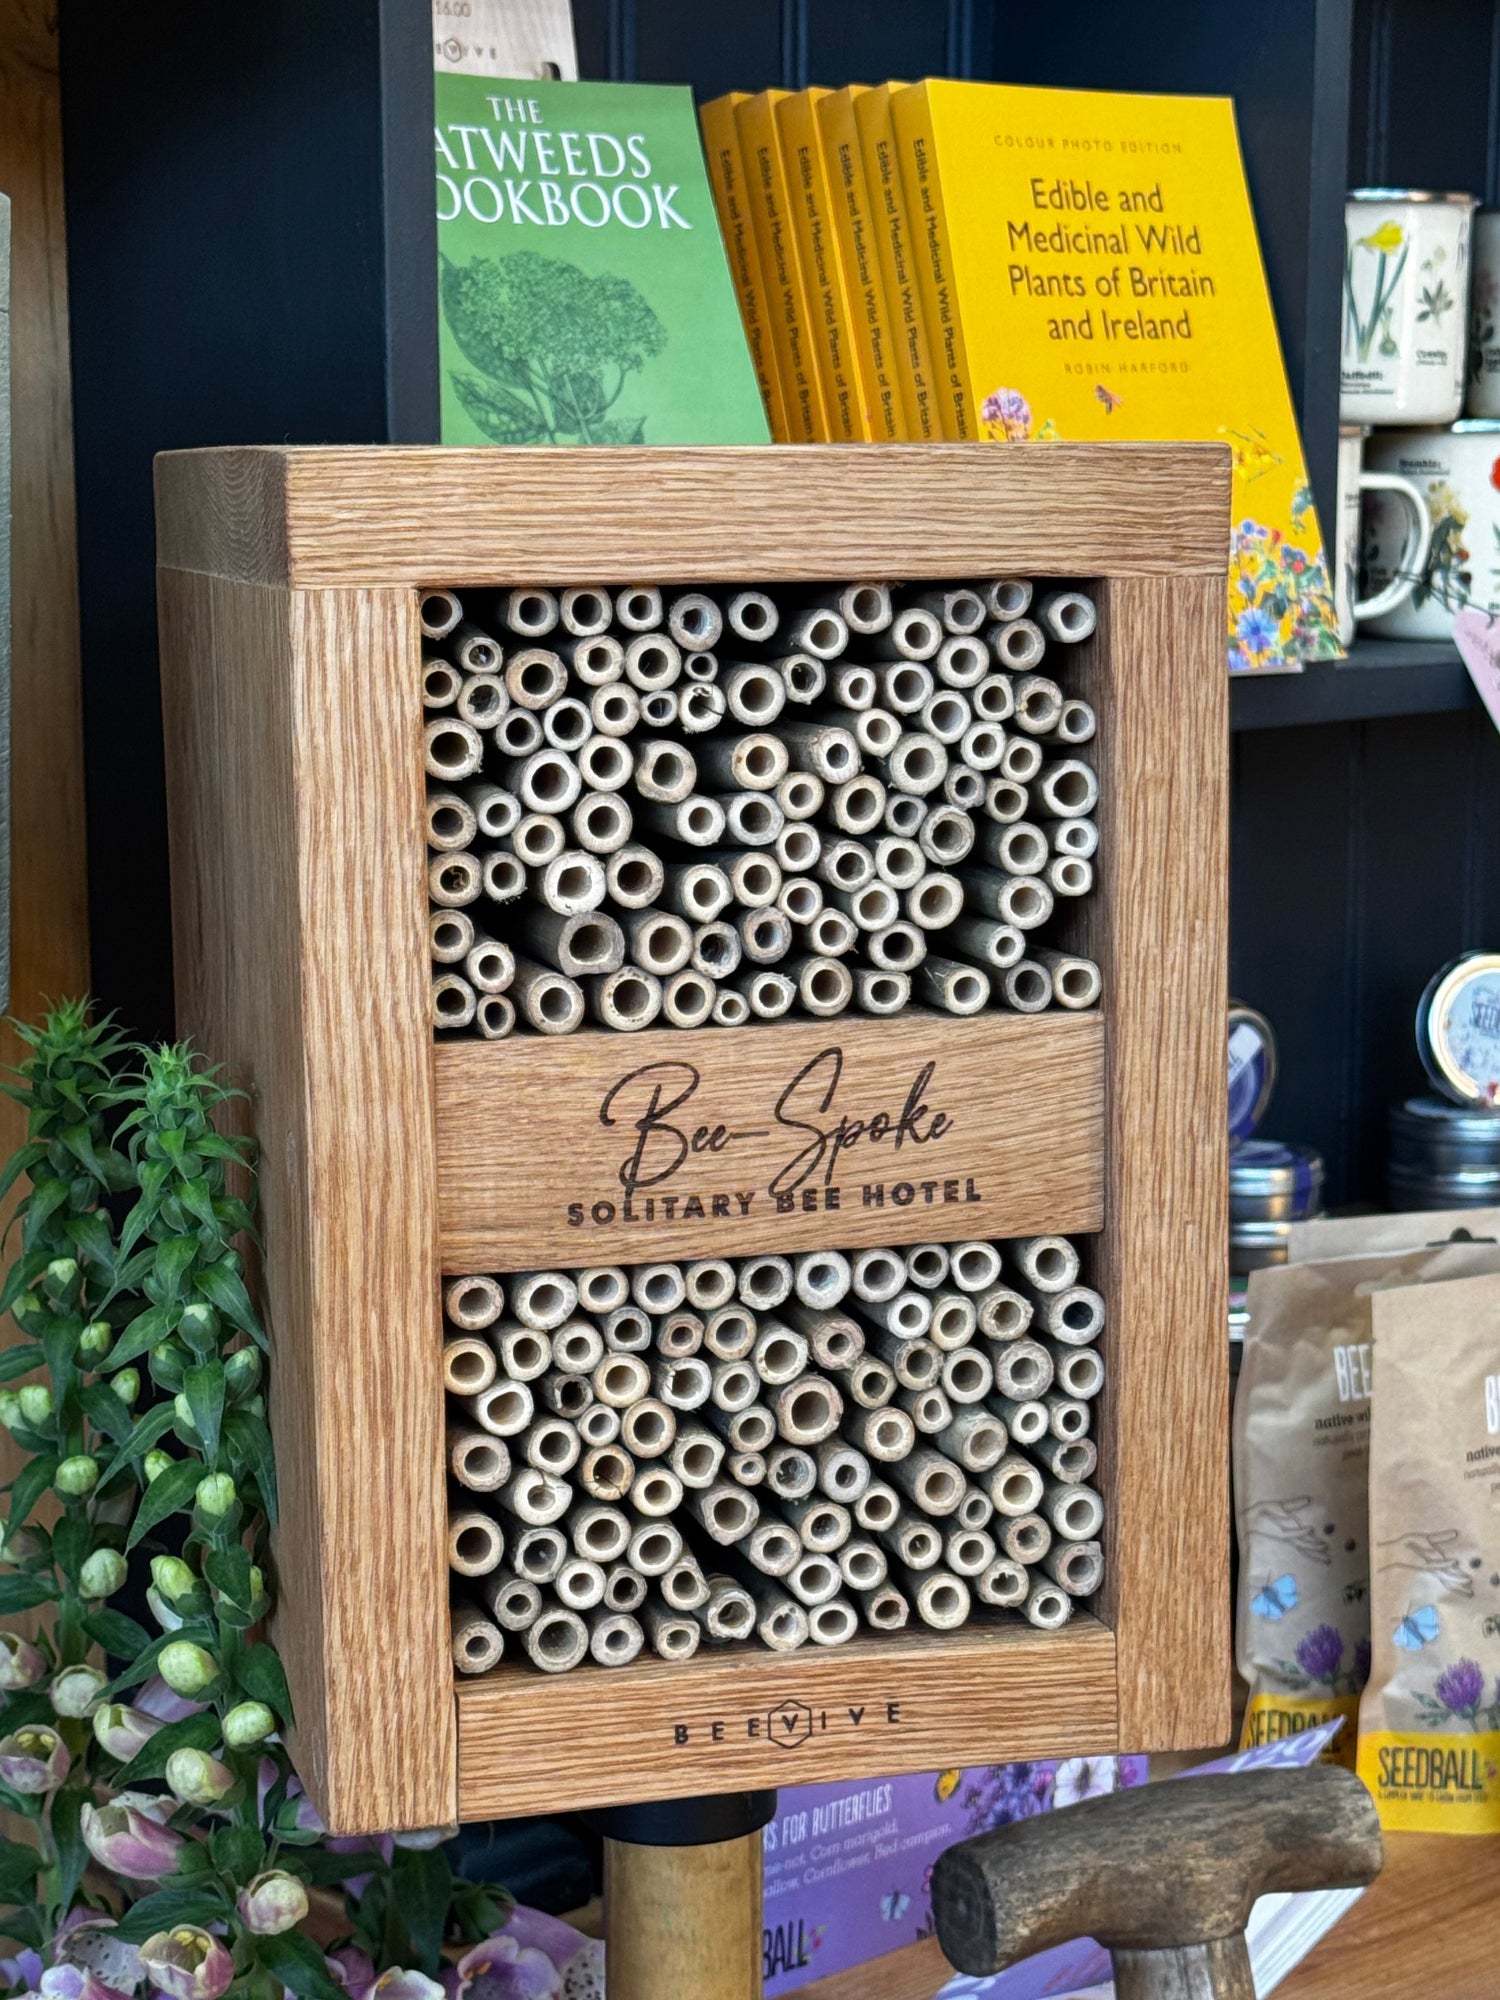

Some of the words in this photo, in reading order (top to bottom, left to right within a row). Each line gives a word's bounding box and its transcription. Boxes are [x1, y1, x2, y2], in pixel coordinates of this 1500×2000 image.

[486, 94, 544, 124] THE
[877, 141, 892, 184] Edible
[913, 138, 928, 182] Edible
[994, 135, 1055, 149] COLOUR
[1062, 139, 1113, 152] PHOTO
[1120, 141, 1183, 154] EDITION
[839, 144, 853, 188] Edible
[847, 191, 860, 217] and
[884, 189, 897, 214] and
[921, 187, 934, 213] and
[1030, 178, 1110, 212] Edible
[1119, 182, 1164, 213] and
[852, 220, 872, 286] Medicinal
[889, 218, 908, 285] Medicinal
[926, 216, 946, 284] Medicinal
[1007, 221, 1128, 255] Medicinal
[1135, 224, 1202, 255] Wild
[1008, 264, 1086, 298] Plants
[1095, 266, 1120, 298] of
[1129, 267, 1216, 298] Britain
[865, 288, 877, 324] Wild
[902, 287, 916, 324] Wild
[939, 287, 952, 324] Wild
[1048, 309, 1093, 341] and
[1102, 309, 1192, 341] Ireland
[870, 327, 883, 369] Plants
[907, 326, 920, 369] Plants
[944, 327, 956, 370] Plants
[878, 374, 890, 387] of
[914, 373, 926, 387] of
[950, 374, 962, 388] of
[1064, 363, 1111, 375] ROBIN
[1118, 362, 1189, 374] HARFORD
[881, 391, 896, 437] Britain
[917, 391, 932, 438] Britain
[953, 391, 968, 439] Britain
[600, 1046, 954, 1198] Bee-Spoke
[567, 1192, 756, 1227] SOLITARY
[776, 1186, 841, 1214] BEE
[863, 1178, 981, 1208] HOTEL
[1315, 1412, 1354, 1430] native
[674, 1700, 901, 1750] BEEVIVE
[1378, 1746, 1483, 1790] SEEDBALL
[782, 1811, 808, 1846] FOR
[812, 1783, 893, 1837] BUTTERFLIES
